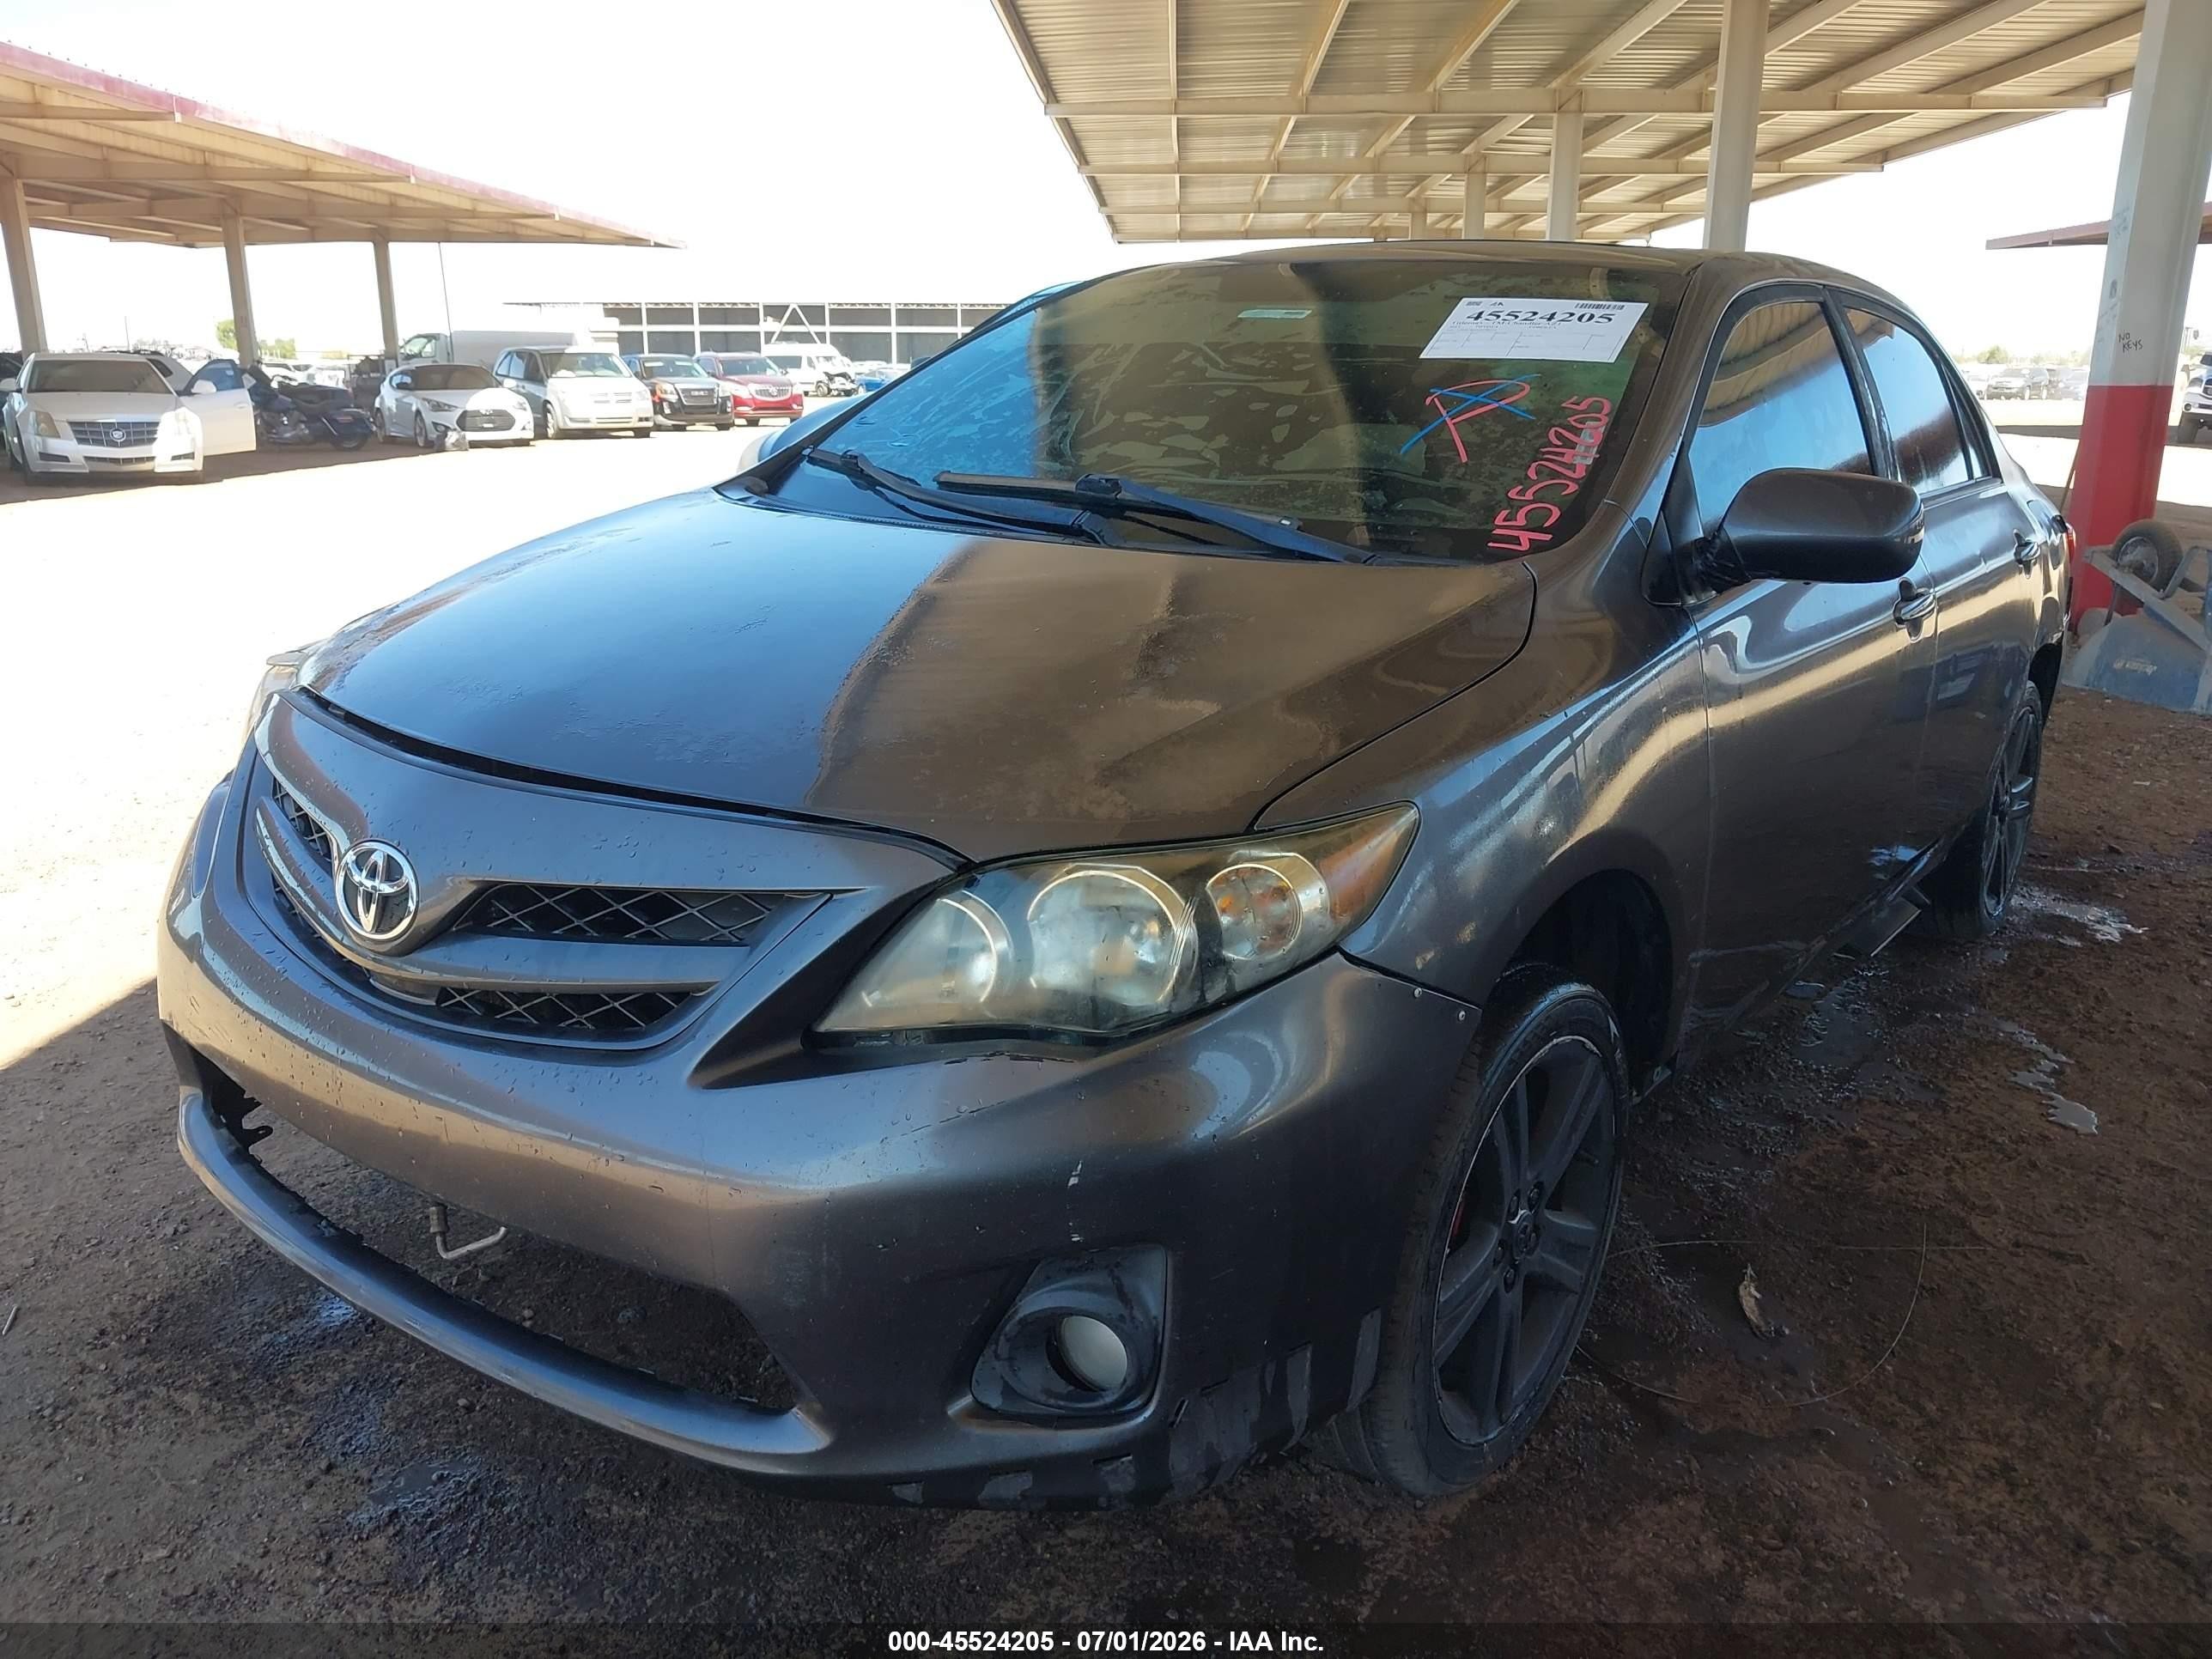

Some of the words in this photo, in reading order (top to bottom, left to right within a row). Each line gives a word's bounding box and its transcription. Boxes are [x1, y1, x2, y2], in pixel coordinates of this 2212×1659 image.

[1466, 310, 1616, 325] 45524205
[2118, 331, 2130, 343] NO
[2123, 339, 2143, 353] KEYS
[1486, 395, 1613, 551] 45524205
